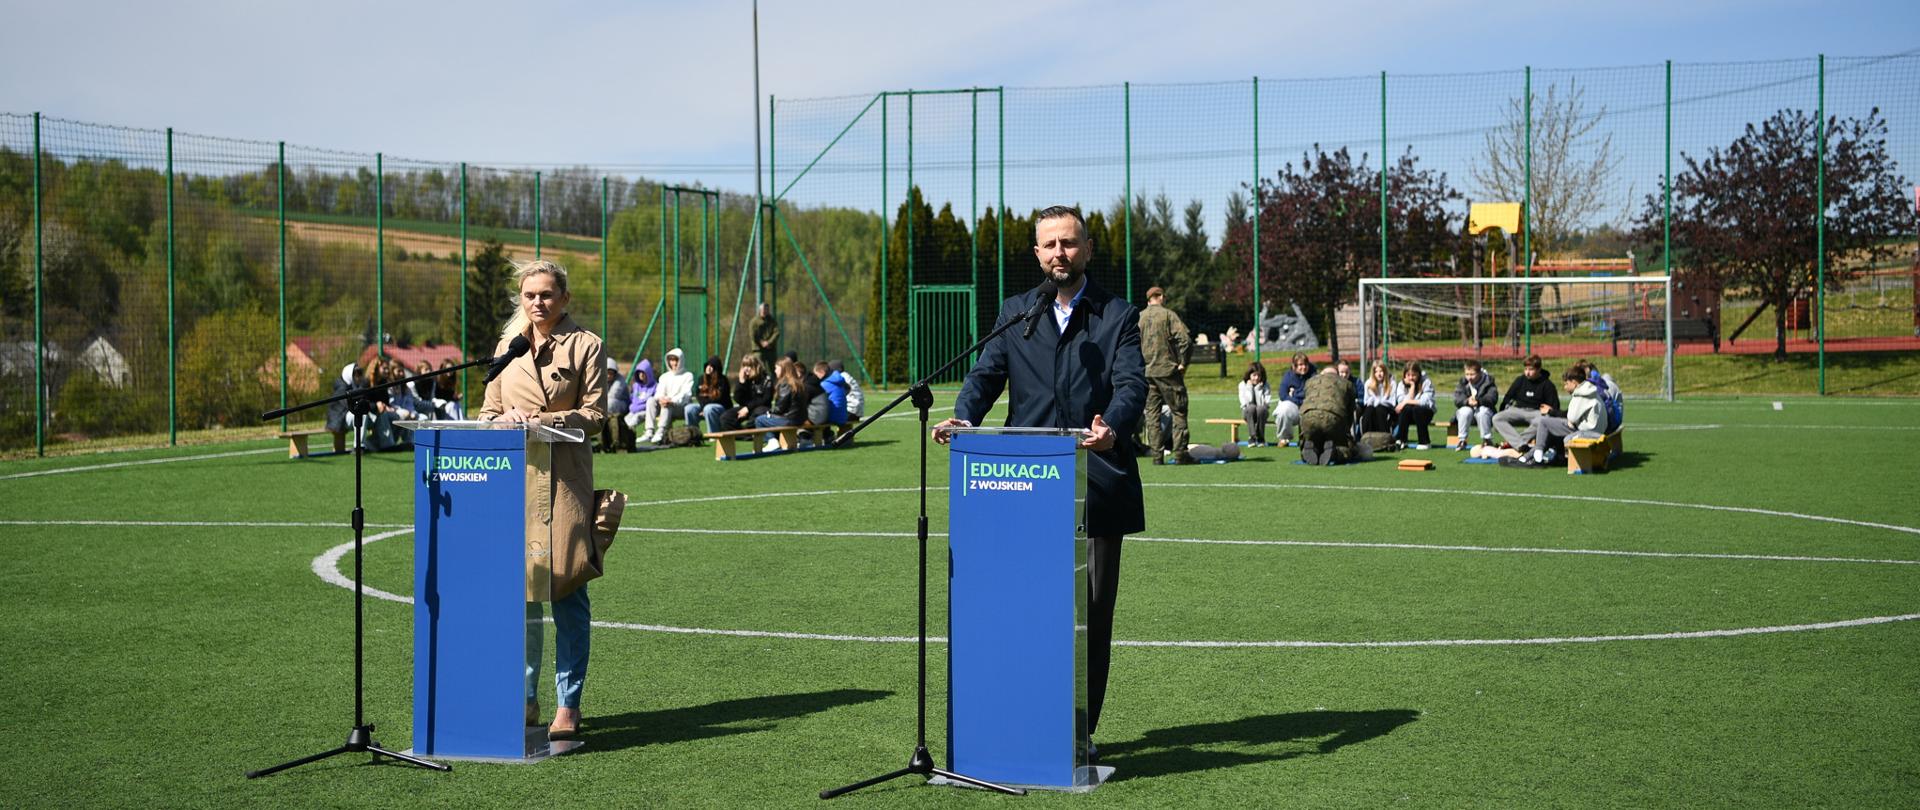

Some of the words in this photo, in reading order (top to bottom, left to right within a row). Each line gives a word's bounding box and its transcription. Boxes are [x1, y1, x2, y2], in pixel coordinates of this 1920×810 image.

[434, 456, 512, 470] EDUKACJA
[433, 472, 439, 481] Z
[439, 472, 488, 482] WOJSKIEM
[970, 462, 1060, 480] EDUKACJA
[970, 480, 977, 490] Z
[978, 480, 1033, 491] WOJSKIEM
